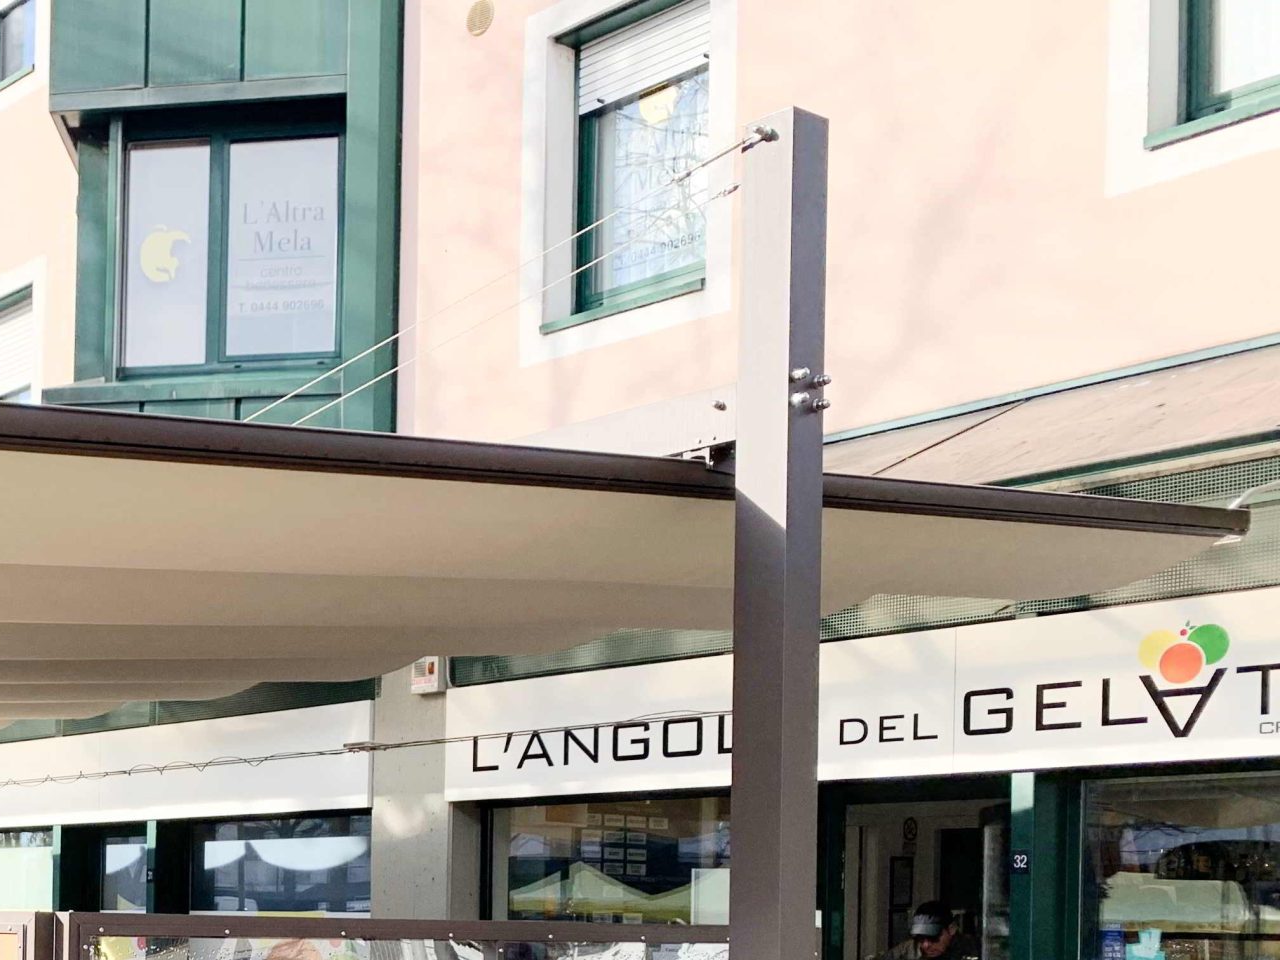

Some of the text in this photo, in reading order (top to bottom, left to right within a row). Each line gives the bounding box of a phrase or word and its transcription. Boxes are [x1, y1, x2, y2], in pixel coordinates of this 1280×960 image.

[243, 200, 326, 225] L'Altra
[254, 229, 312, 252] Mela
[472, 713, 733, 772] L'ANGOL
[839, 713, 938, 745] DEL
[1014, 855, 1027, 868] 32
